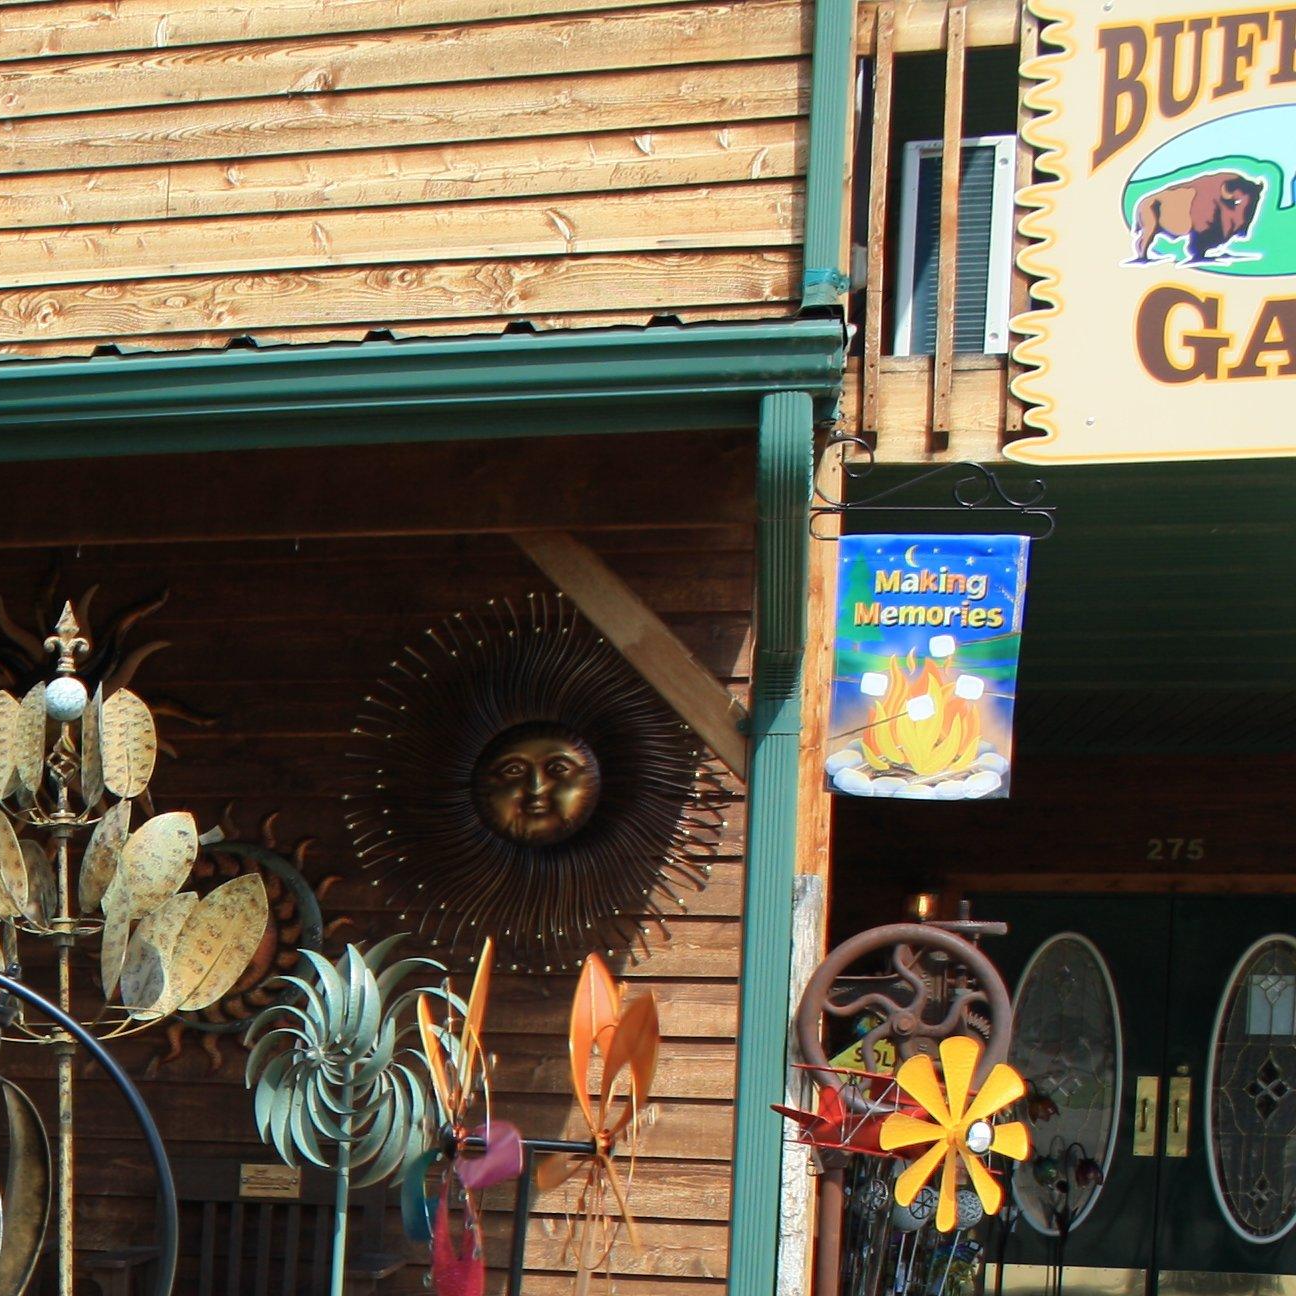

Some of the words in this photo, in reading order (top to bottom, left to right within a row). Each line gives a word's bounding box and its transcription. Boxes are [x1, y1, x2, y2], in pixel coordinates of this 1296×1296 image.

[1136, 286, 1296, 384] GA
[874, 567, 989, 601] Making
[854, 600, 1005, 628] Memories
[1147, 838, 1205, 860] 275
